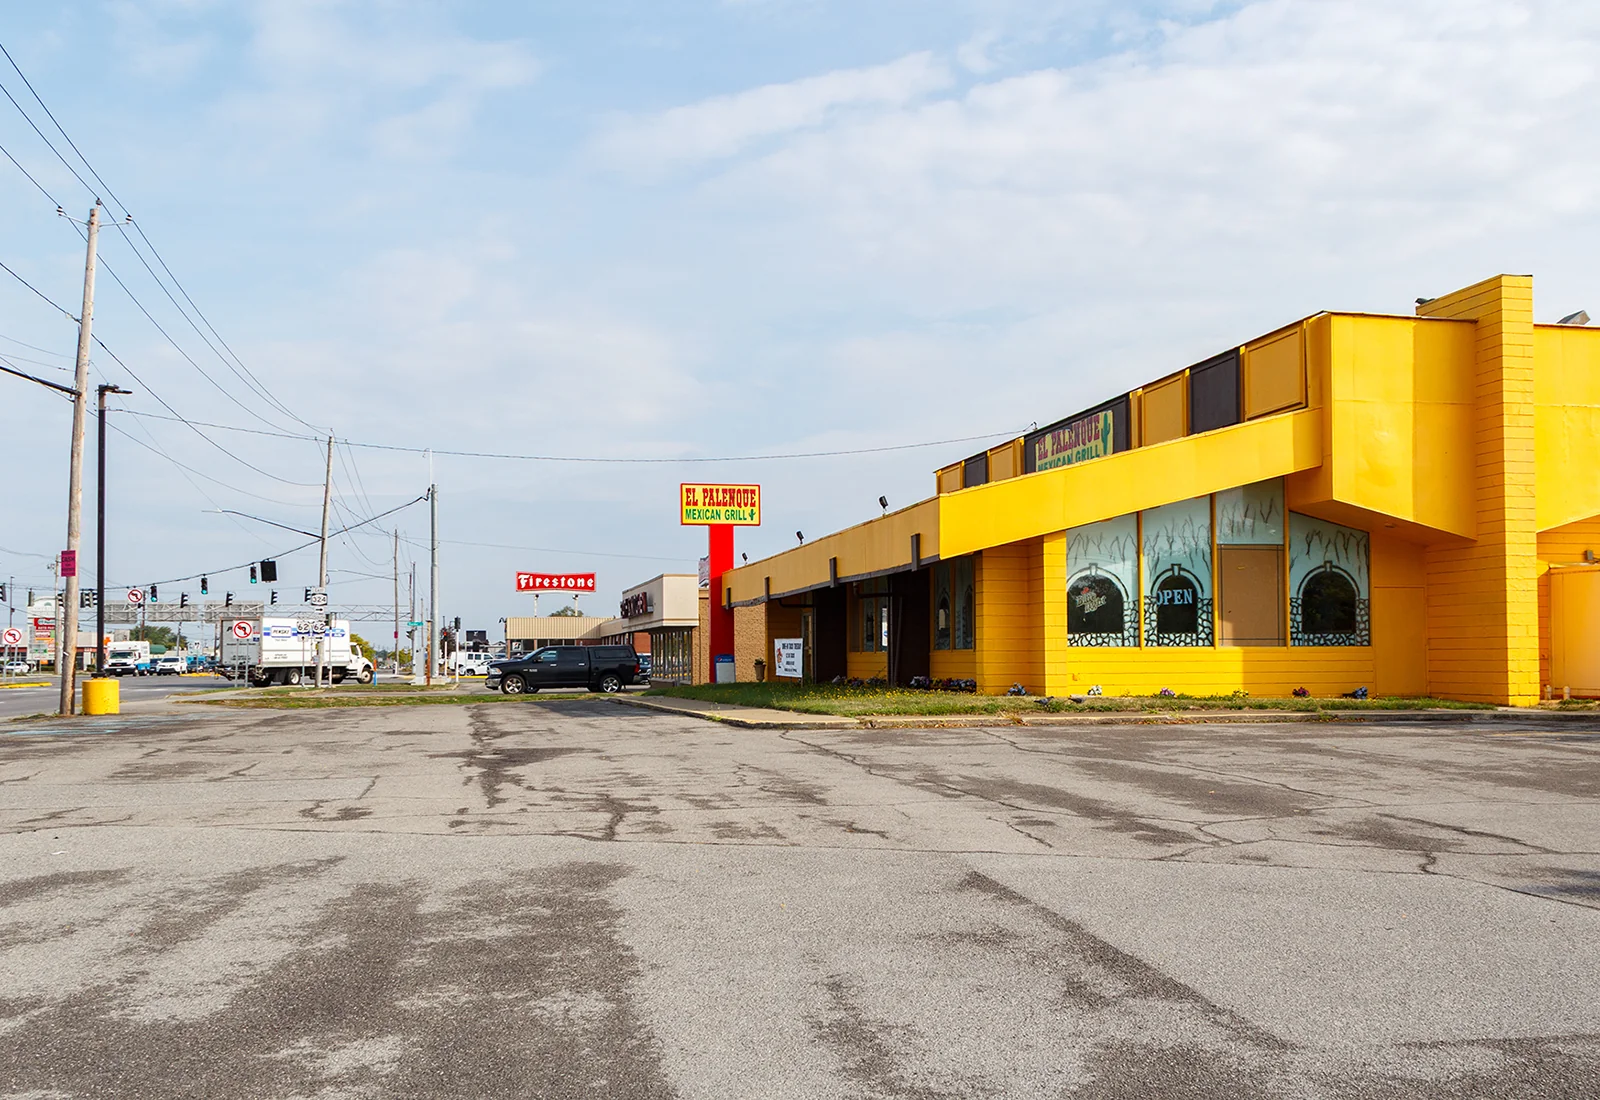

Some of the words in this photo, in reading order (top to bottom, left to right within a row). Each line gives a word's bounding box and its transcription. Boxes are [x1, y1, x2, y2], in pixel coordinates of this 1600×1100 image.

[1038, 436, 1048, 461] EL
[1051, 414, 1100, 456] PALENQUE
[1075, 444, 1100, 462] GRILL
[685, 488, 699, 506] EL
[702, 488, 756, 508] PALENQUE
[685, 509, 721, 521] MEXICAN
[724, 509, 747, 521] GRILL
[518, 574, 594, 588] Firestone
[1156, 588, 1193, 606] OPEN
[298, 623, 309, 631] 62
[314, 623, 325, 631] 62
